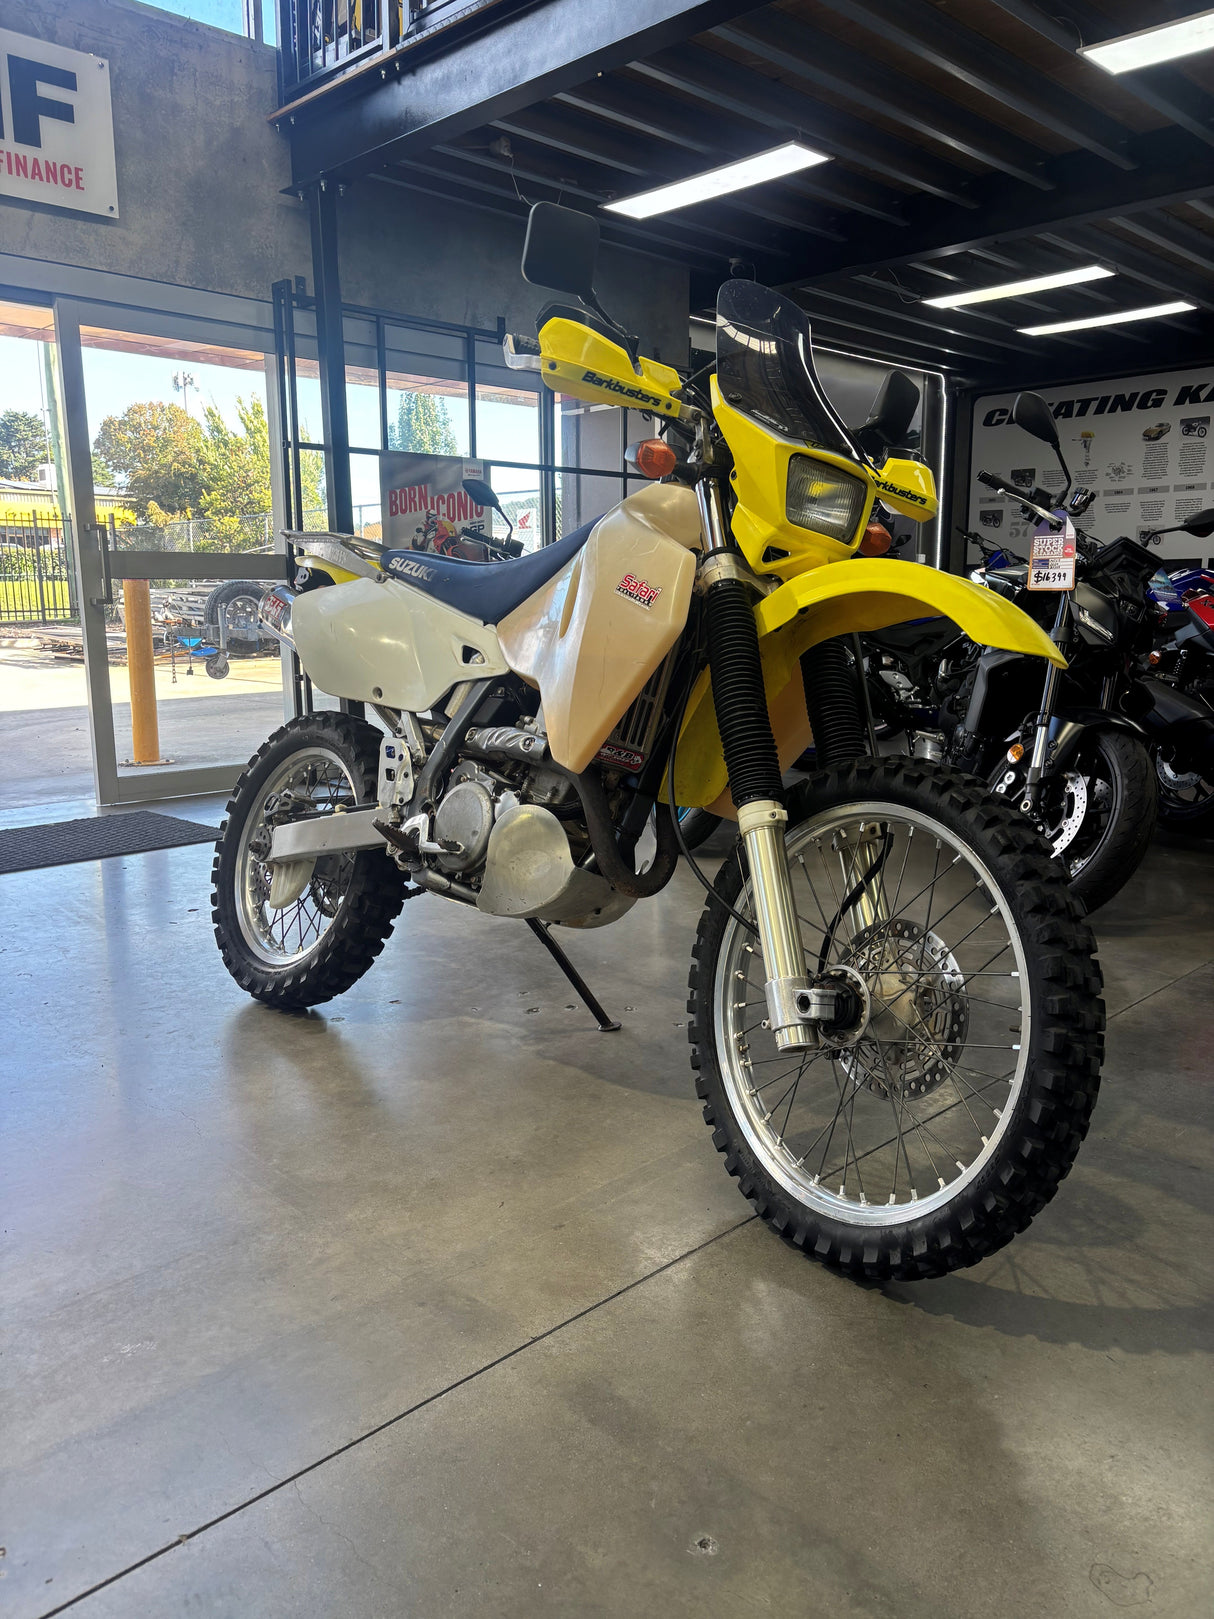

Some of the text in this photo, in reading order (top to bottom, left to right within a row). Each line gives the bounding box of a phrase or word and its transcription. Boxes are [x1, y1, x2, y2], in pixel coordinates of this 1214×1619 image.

[0, 53, 77, 149] F
[582, 371, 662, 407] Barkbusters
[982, 388, 1168, 427] CATING
[388, 484, 428, 517] BORN
[872, 476, 927, 505] arkbusters
[1009, 521, 1030, 538] 57
[1034, 538, 1063, 546] SUPER
[389, 556, 438, 582] SUZUKI
[620, 574, 661, 602] Safari
